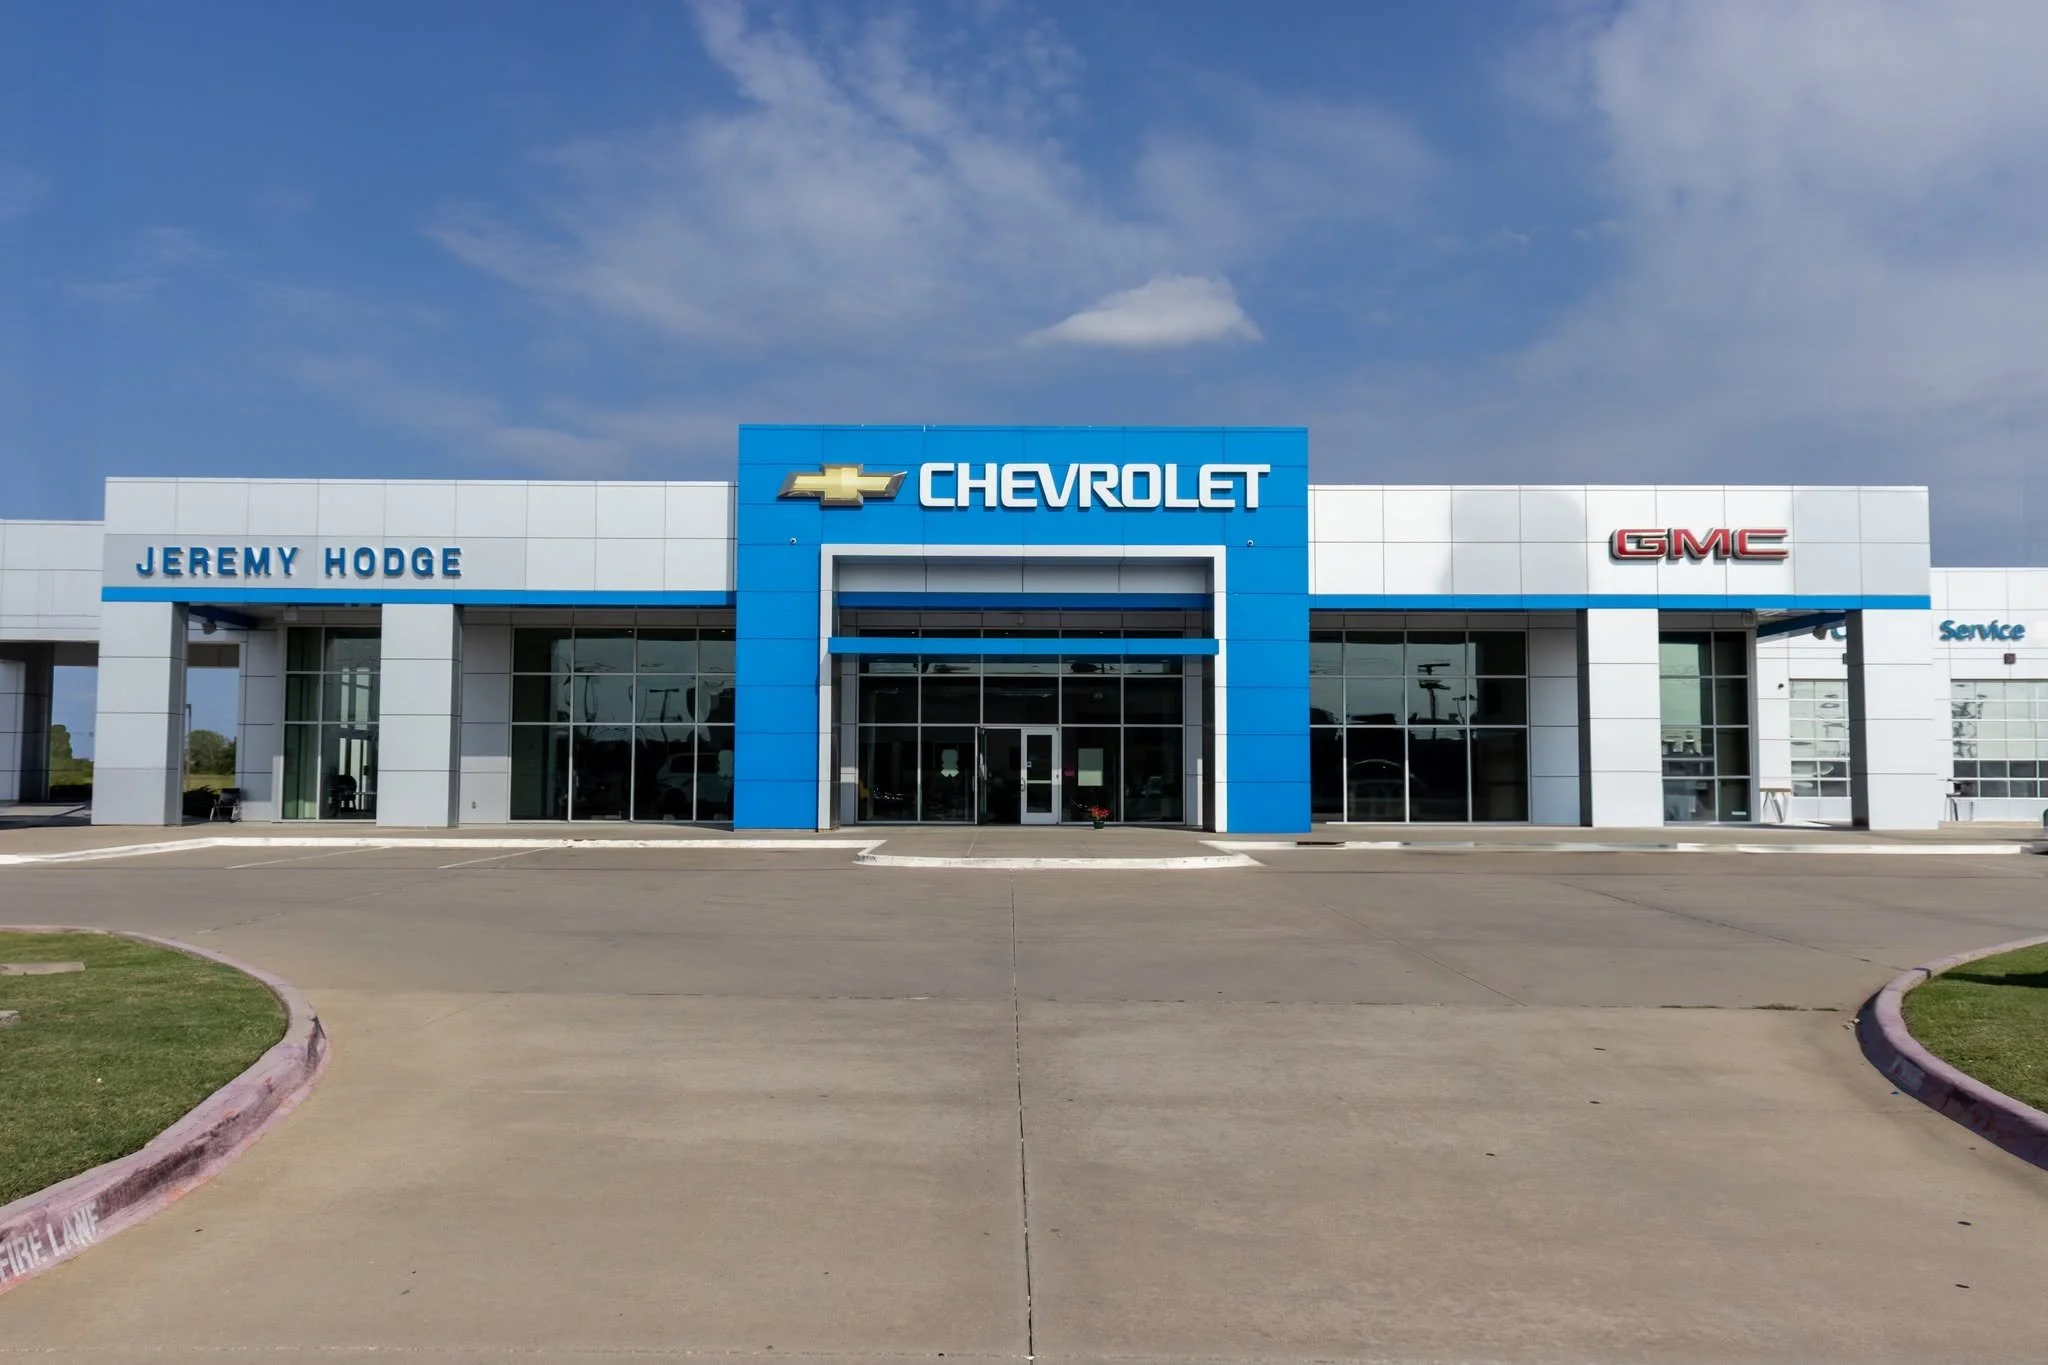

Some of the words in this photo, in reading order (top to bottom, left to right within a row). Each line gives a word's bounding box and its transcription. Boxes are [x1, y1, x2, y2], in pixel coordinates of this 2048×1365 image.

[919, 462, 1271, 510] CHEVROLET
[1611, 527, 1789, 561] GMC
[136, 545, 299, 577] JEREMY
[325, 546, 463, 577] HODGE
[1938, 619, 2025, 641] Service
